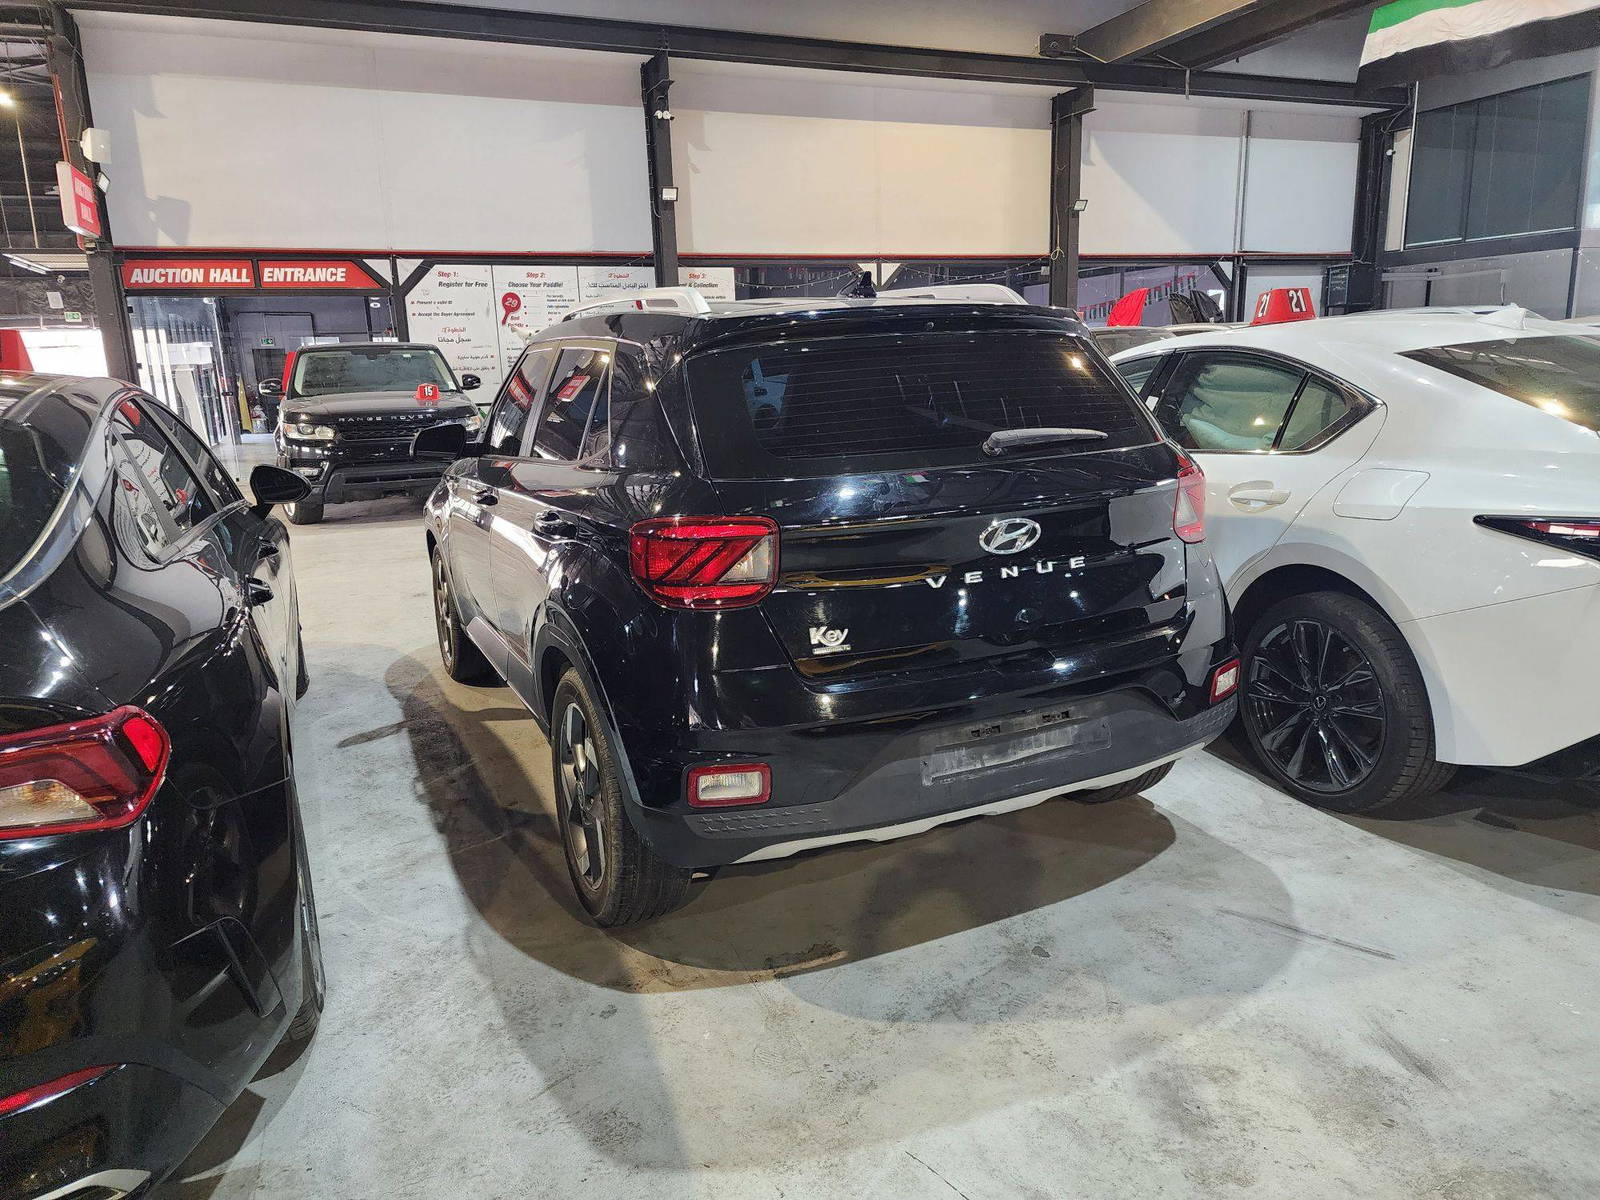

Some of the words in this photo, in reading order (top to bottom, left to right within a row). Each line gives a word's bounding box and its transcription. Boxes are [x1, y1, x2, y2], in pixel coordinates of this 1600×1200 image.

[130, 267, 204, 284] AUCTION
[209, 267, 251, 284] HALL
[263, 266, 346, 282] ENTRANCE
[437, 271, 451, 279] Step
[1257, 292, 1271, 318] 21
[1288, 289, 1307, 313] 21
[424, 386, 433, 397] 15
[390, 413, 433, 421] ROVER
[924, 555, 1086, 589] VENUE
[809, 625, 849, 647] Key
